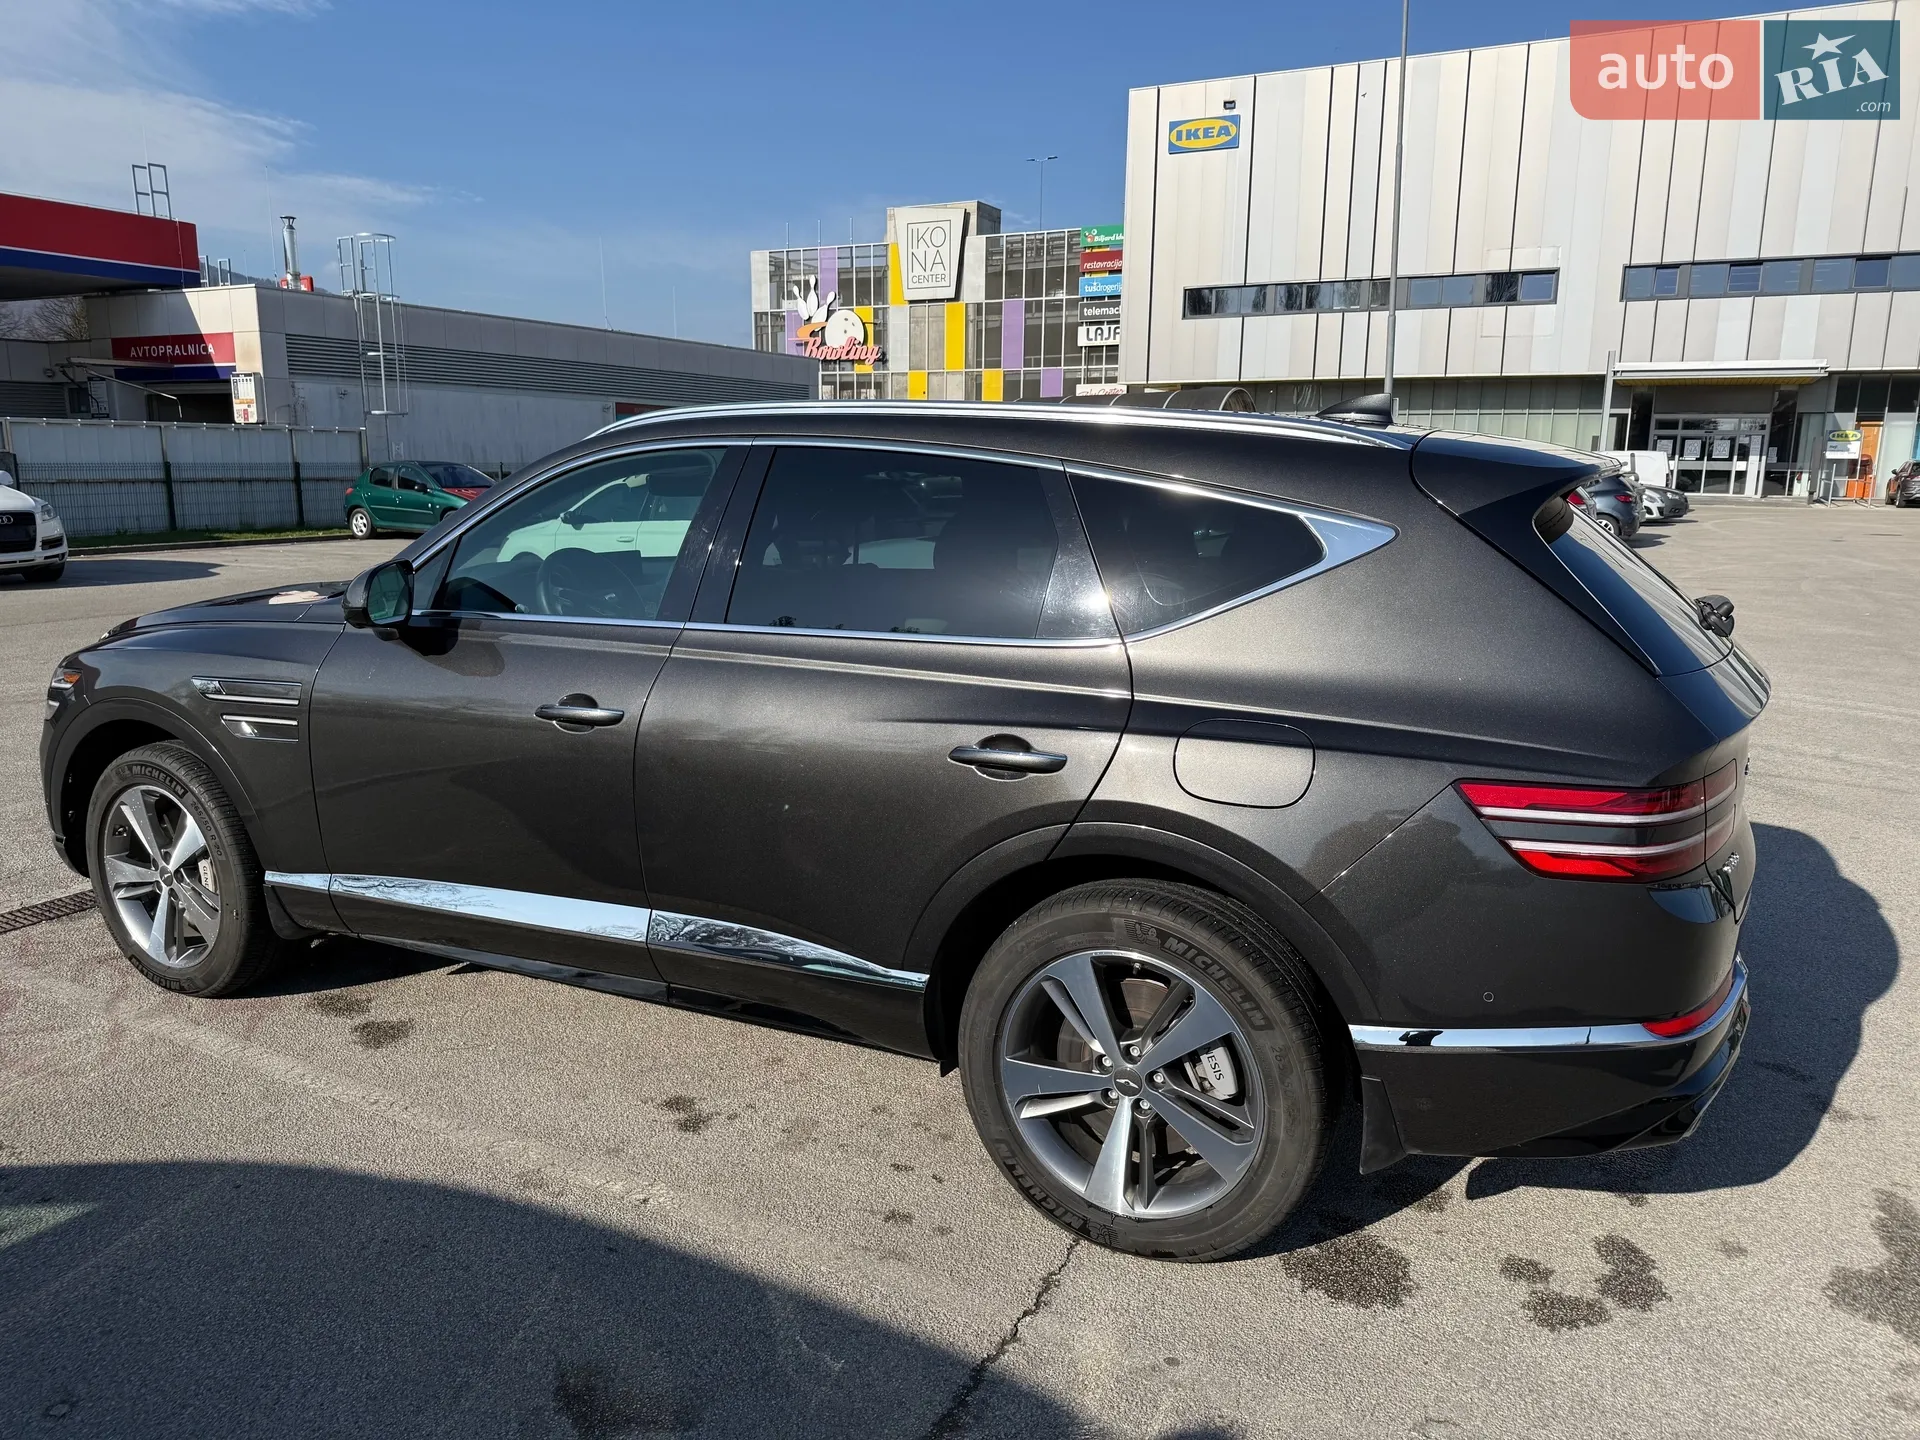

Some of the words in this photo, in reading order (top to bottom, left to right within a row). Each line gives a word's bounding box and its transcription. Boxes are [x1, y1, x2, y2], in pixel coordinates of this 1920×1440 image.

[1175, 125, 1232, 142] IKEA
[911, 273, 947, 284] CENTER
[1083, 259, 1123, 270] restavracija
[130, 343, 215, 358] AVTOPRALNICA
[804, 336, 881, 366] Bowling
[131, 765, 185, 797] MICHELIN
[130, 956, 180, 991] MICHELIN
[1163, 937, 1267, 1027] MICHELIN
[995, 1142, 1084, 1230] MICHELIN
